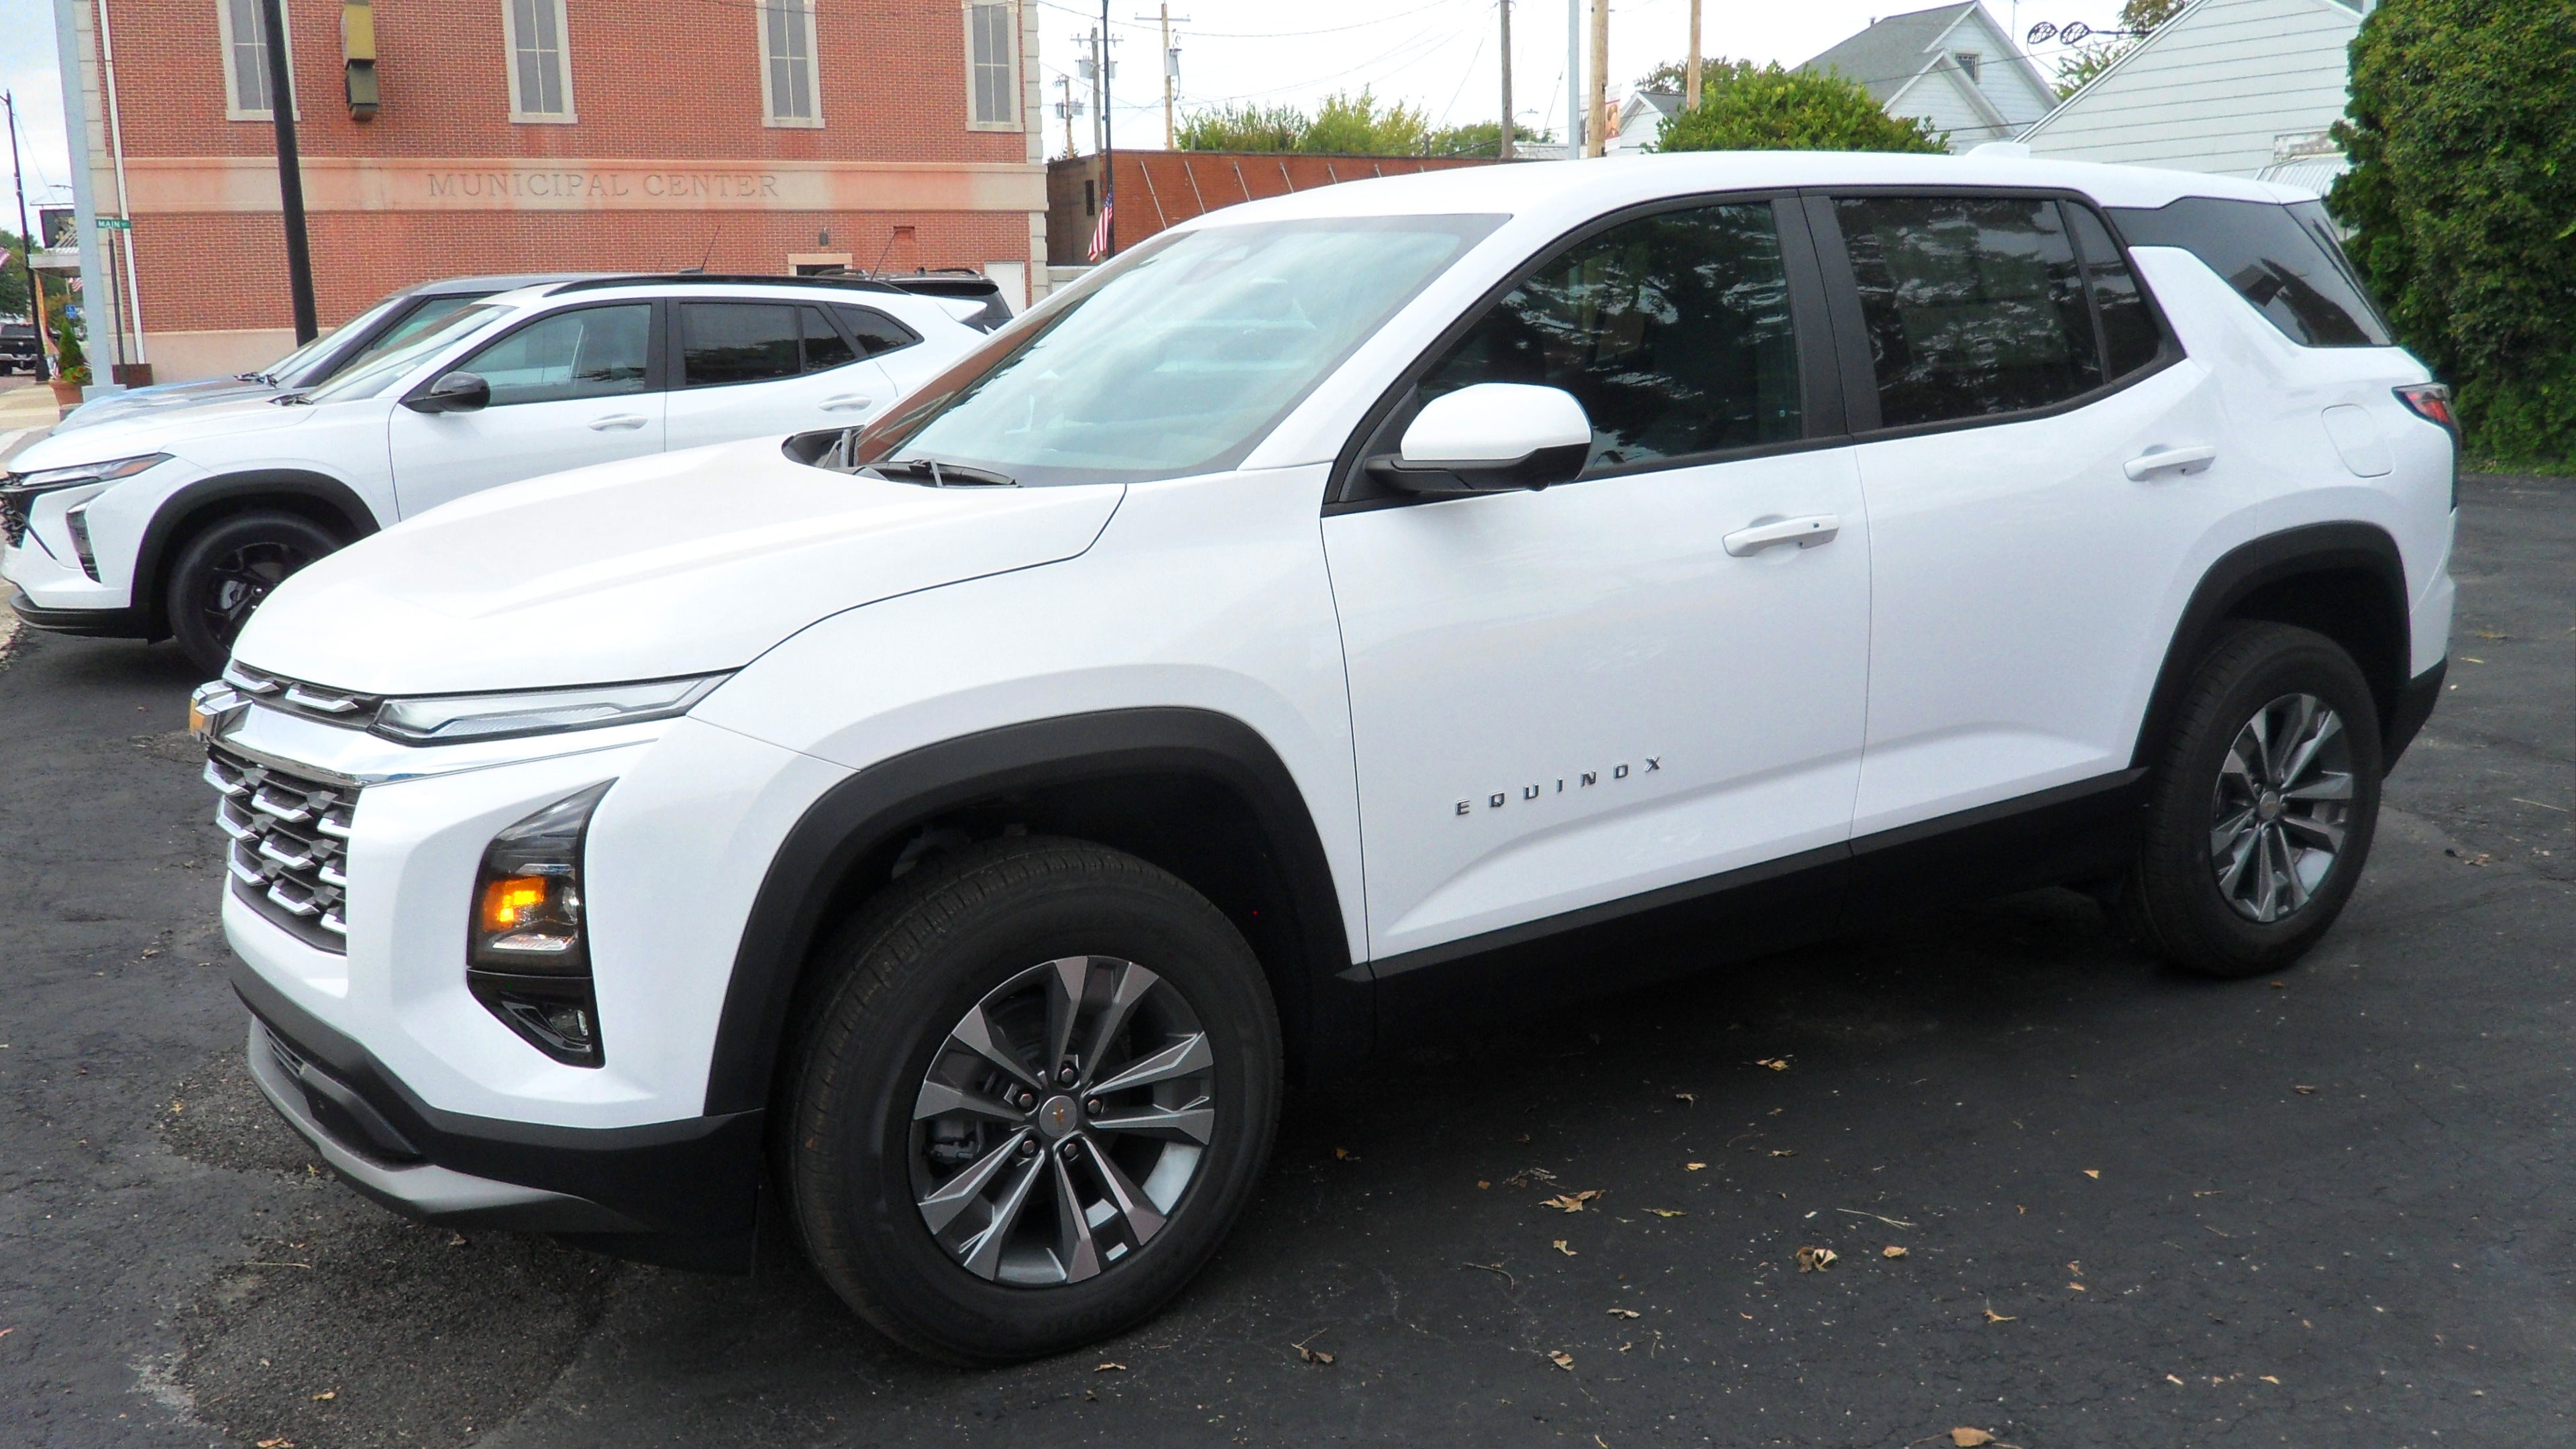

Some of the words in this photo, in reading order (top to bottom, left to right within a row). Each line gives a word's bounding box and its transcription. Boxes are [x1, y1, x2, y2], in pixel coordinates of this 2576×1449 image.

[427, 174, 629, 197] MUNICIPAL
[643, 174, 779, 197] CENTER
[98, 220, 120, 228] MAIN
[1454, 756, 1660, 816] EQUINOX
